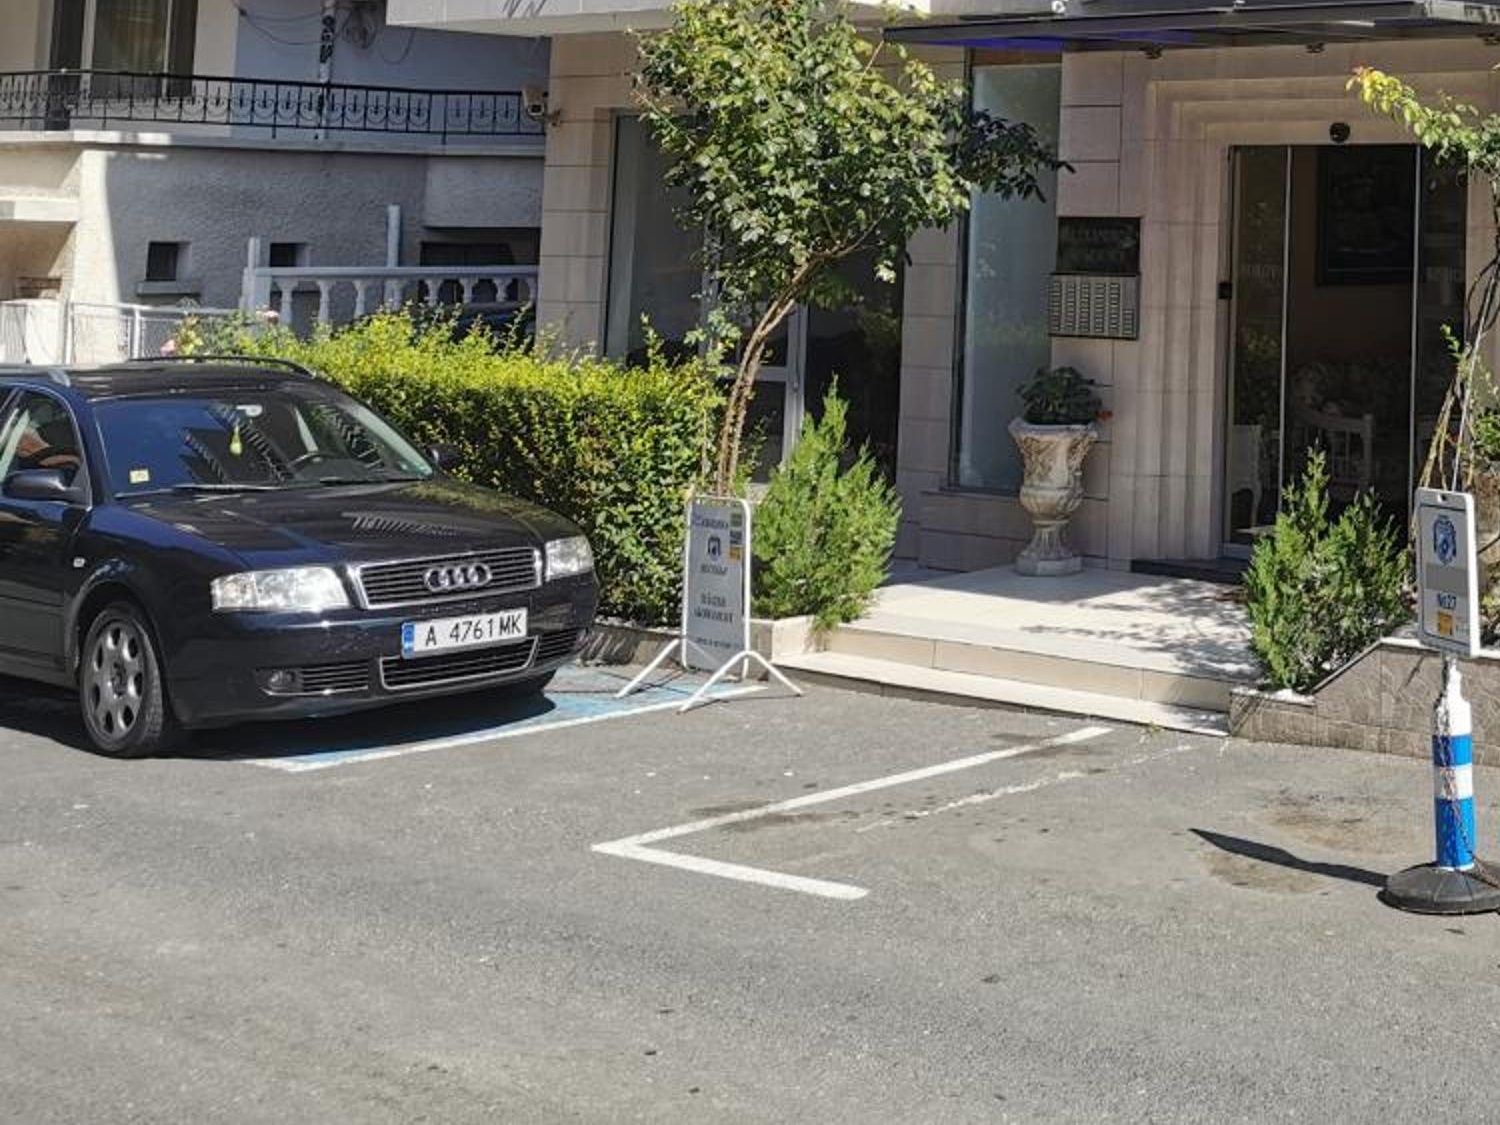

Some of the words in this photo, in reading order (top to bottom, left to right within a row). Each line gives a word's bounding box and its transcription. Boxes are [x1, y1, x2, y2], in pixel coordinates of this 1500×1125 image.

[426, 626, 437, 646] A
[450, 619, 494, 643] 4761
[499, 614, 522, 636] MK
